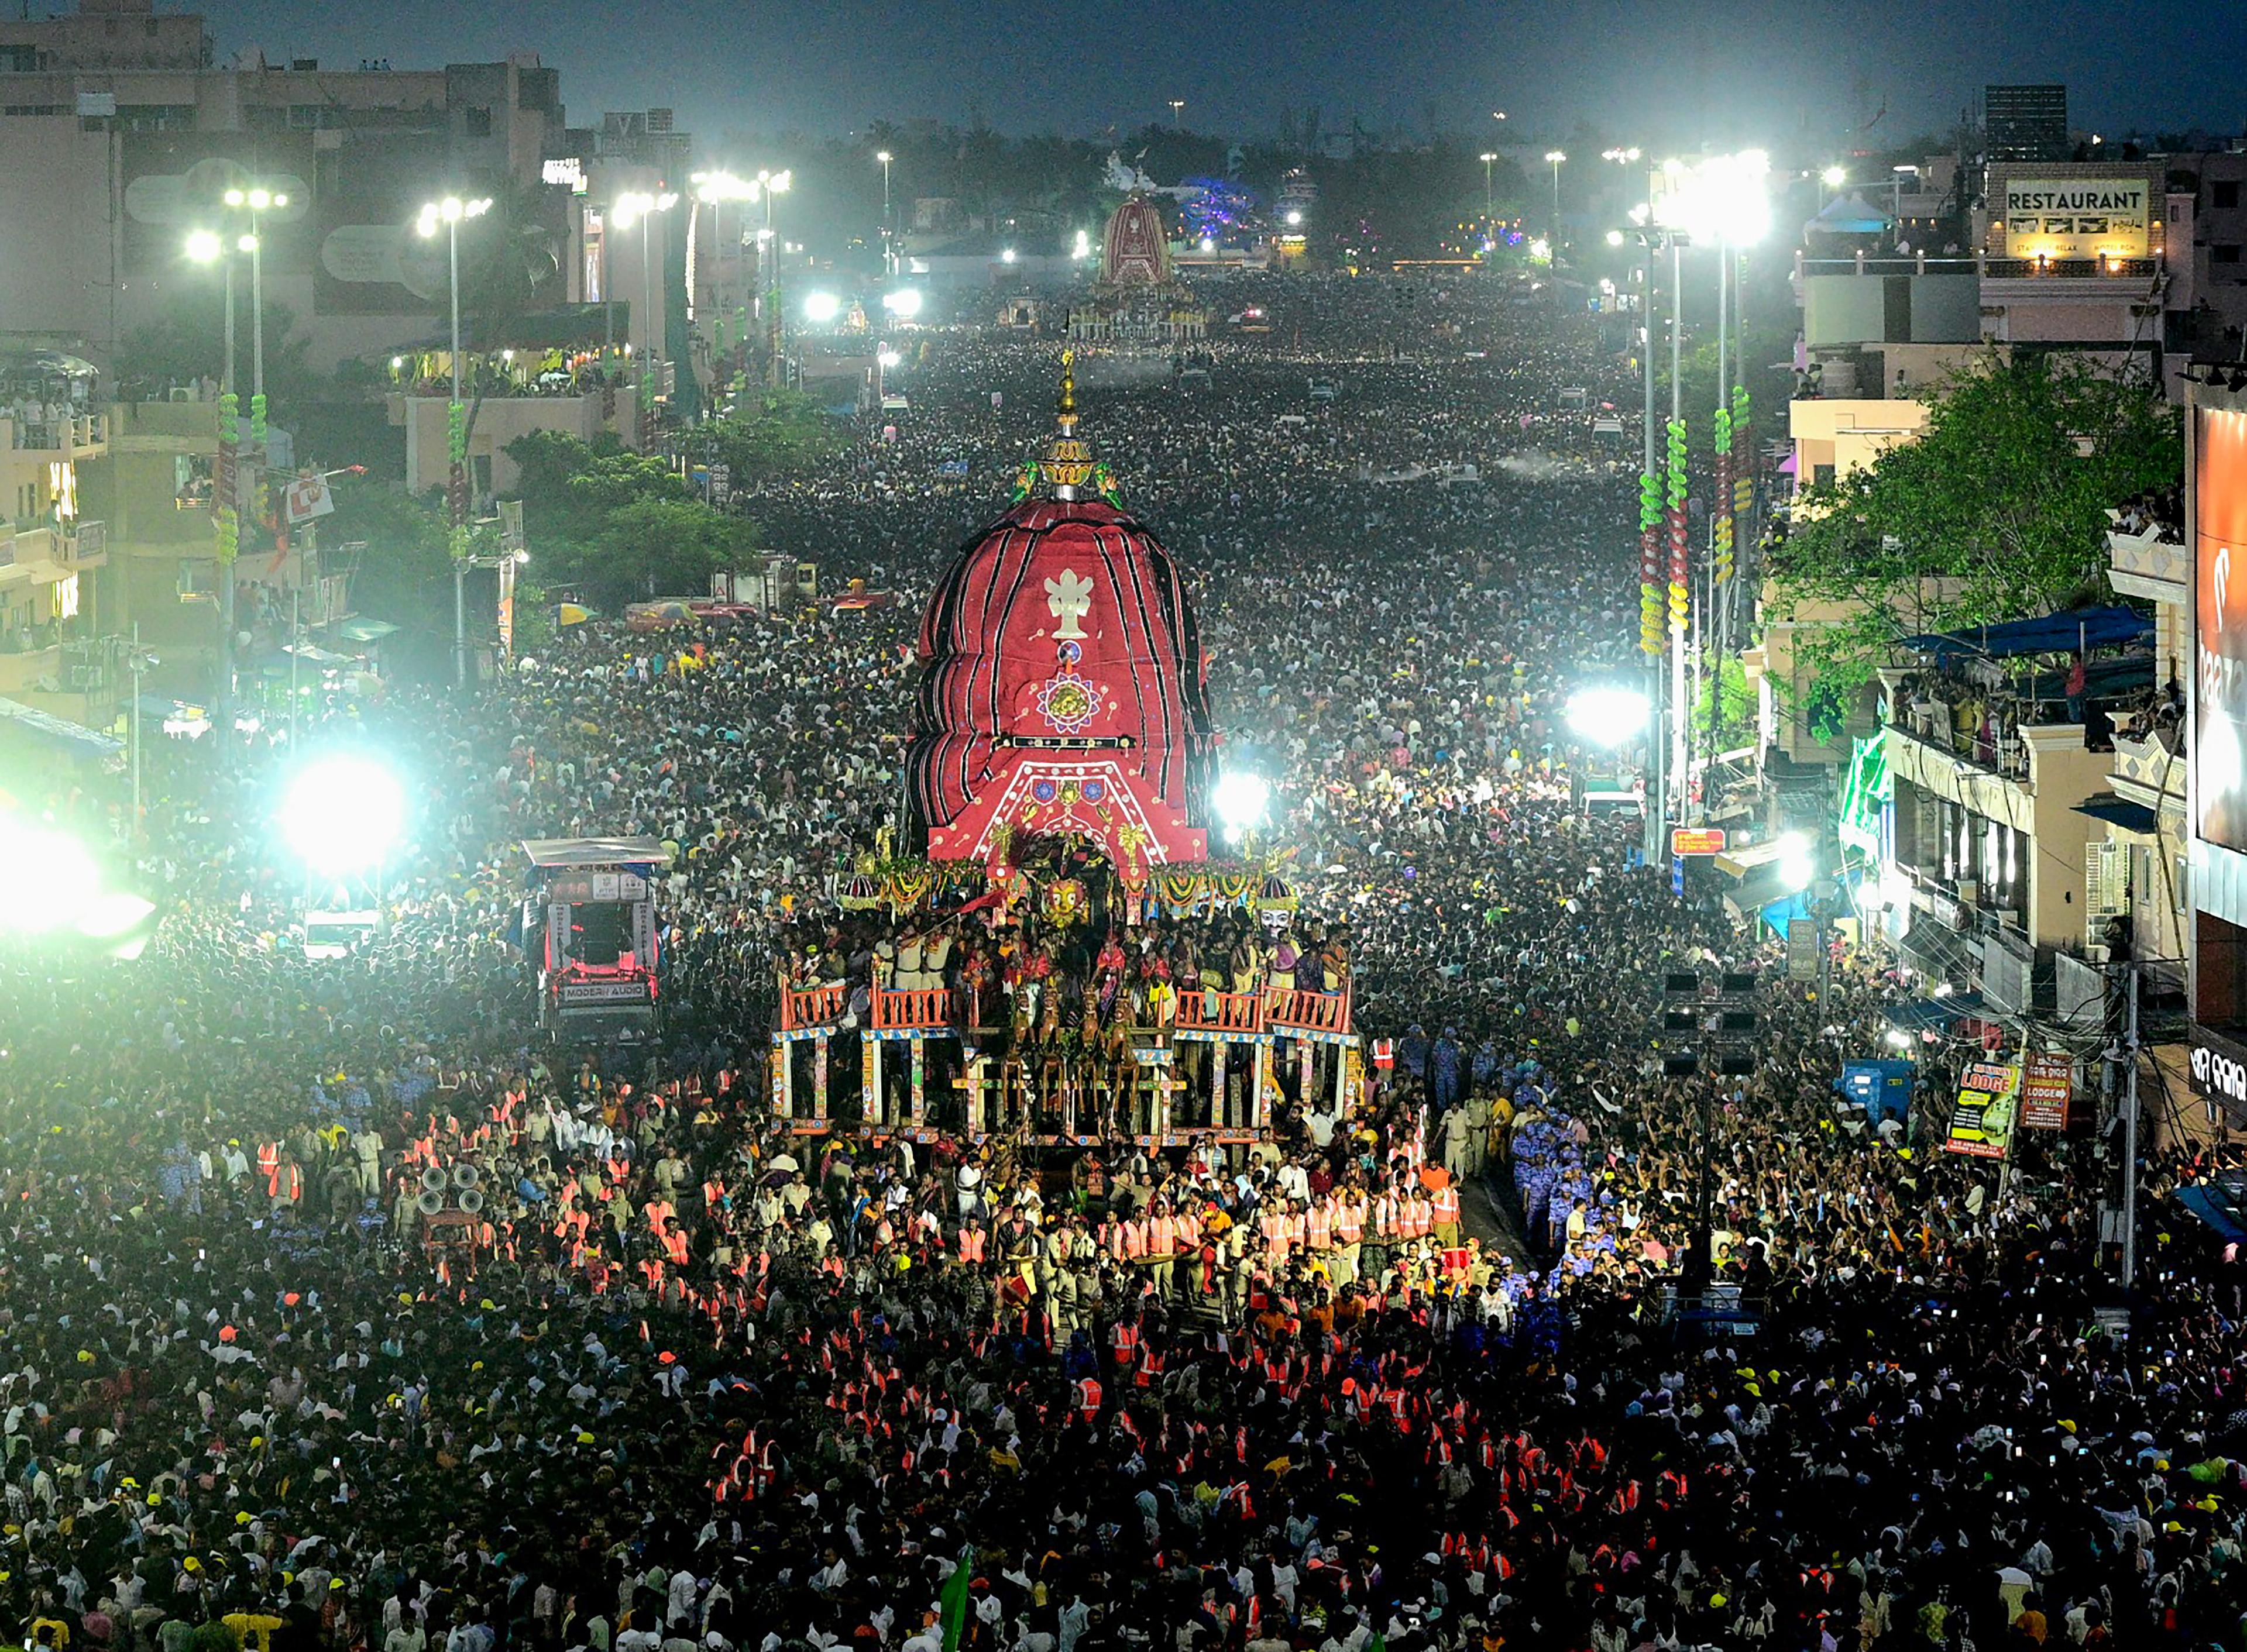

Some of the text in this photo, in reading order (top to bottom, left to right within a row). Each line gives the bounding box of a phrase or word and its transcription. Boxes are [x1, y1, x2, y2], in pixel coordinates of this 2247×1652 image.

[2008, 192, 2141, 209] RESTAURANT
[566, 986, 643, 997] MODERN AUDIO
[1961, 1072, 2011, 1093] LODGE
[2027, 1087, 2056, 1098] LODGE
